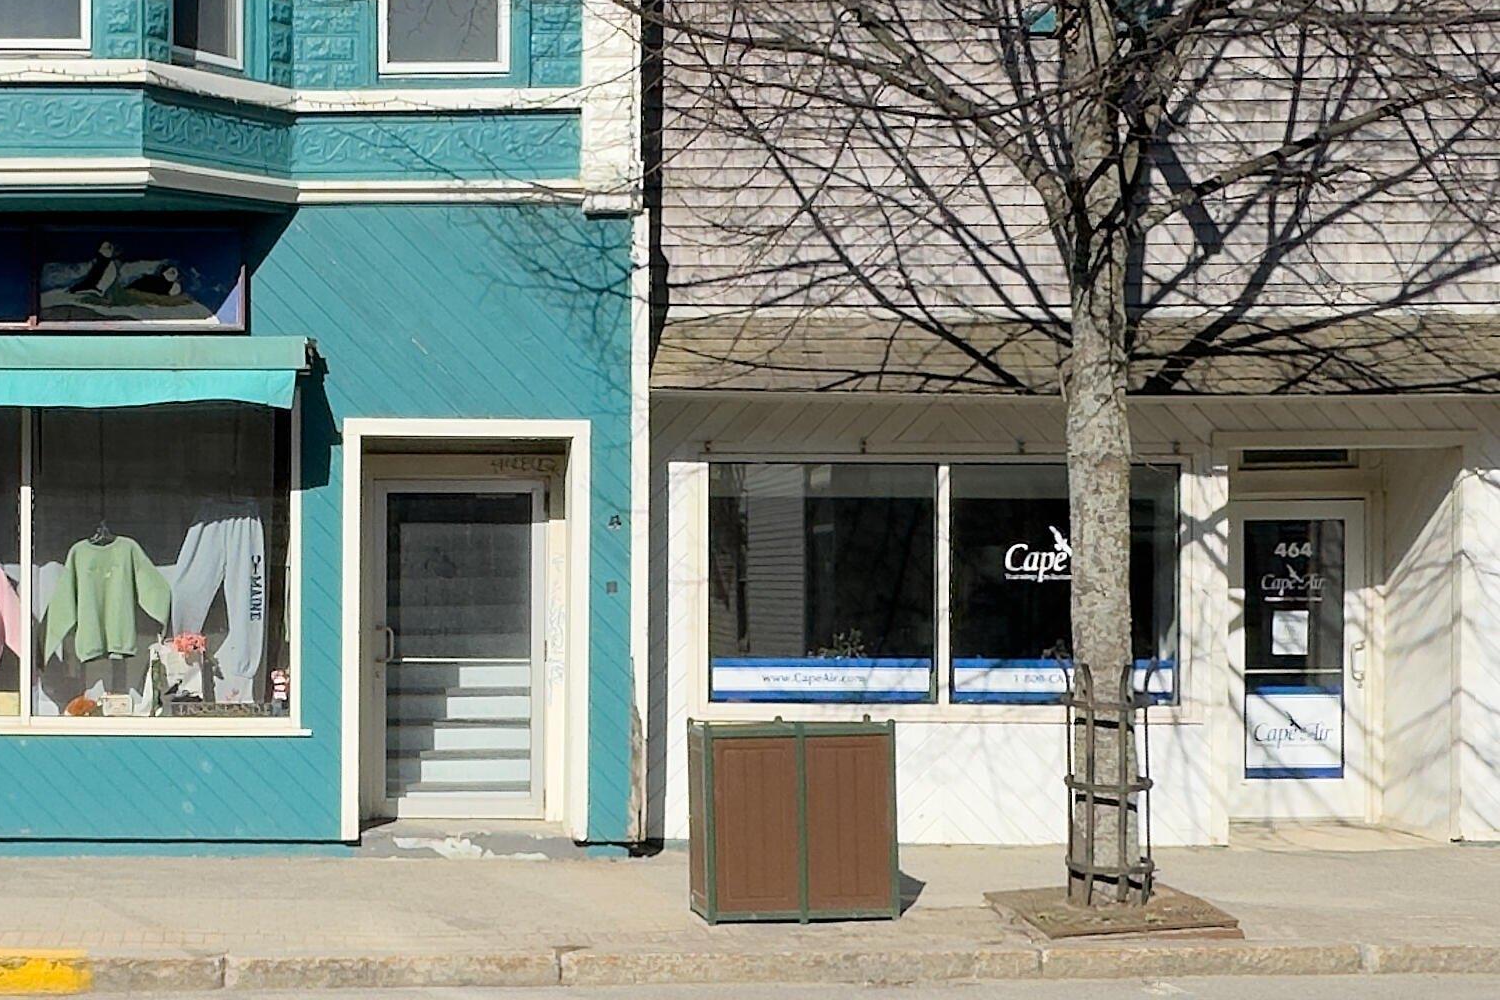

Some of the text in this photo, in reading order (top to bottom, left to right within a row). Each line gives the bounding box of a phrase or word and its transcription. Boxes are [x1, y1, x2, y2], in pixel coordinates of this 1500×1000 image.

[1005, 543, 1068, 582] Cape
[1274, 542, 1313, 558] 464
[1261, 573, 1327, 597] Cape Air
[1254, 722, 1298, 749] Cape
